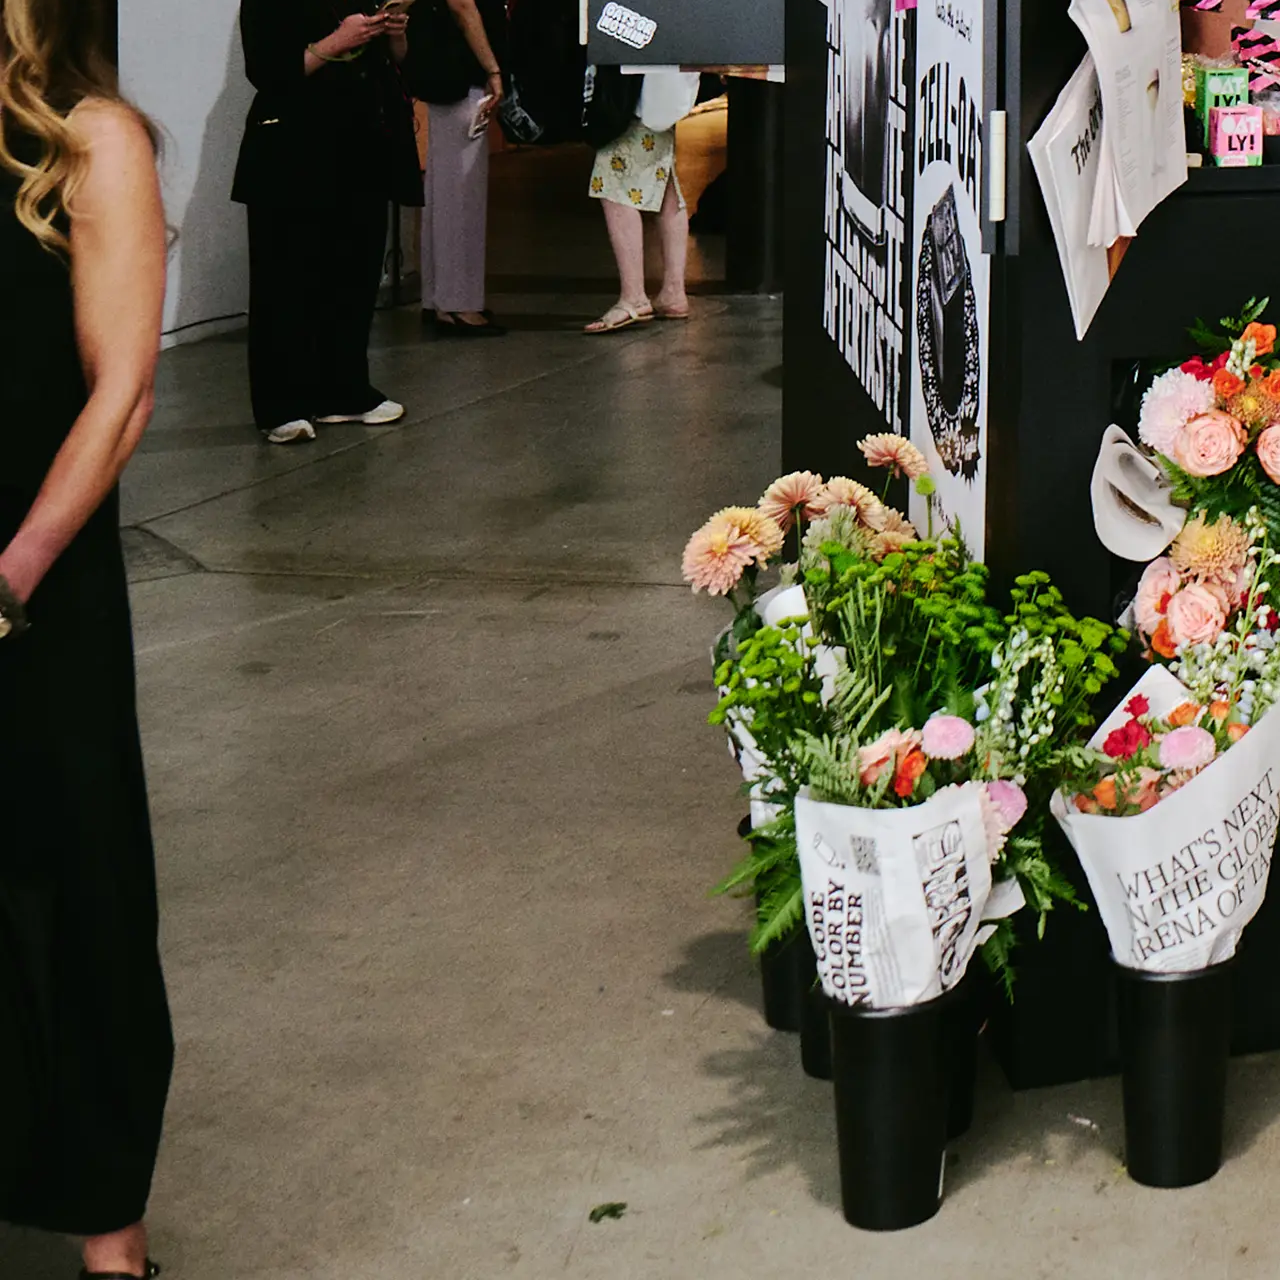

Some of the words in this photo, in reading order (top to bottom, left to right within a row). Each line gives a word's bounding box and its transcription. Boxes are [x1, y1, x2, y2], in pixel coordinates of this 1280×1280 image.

[1071, 128, 1091, 175] The
[1228, 134, 1255, 152] LY!
[823, 240, 903, 435] AFTERTASTE
[1116, 828, 1222, 900] WHAT'S
[1222, 768, 1272, 843] NEXT
[828, 878, 845, 912] BY
[1152, 868, 1213, 916] THE
[1216, 876, 1250, 918] OF
[811, 891, 826, 961] CODE
[846, 893, 874, 1008] NUMBER
